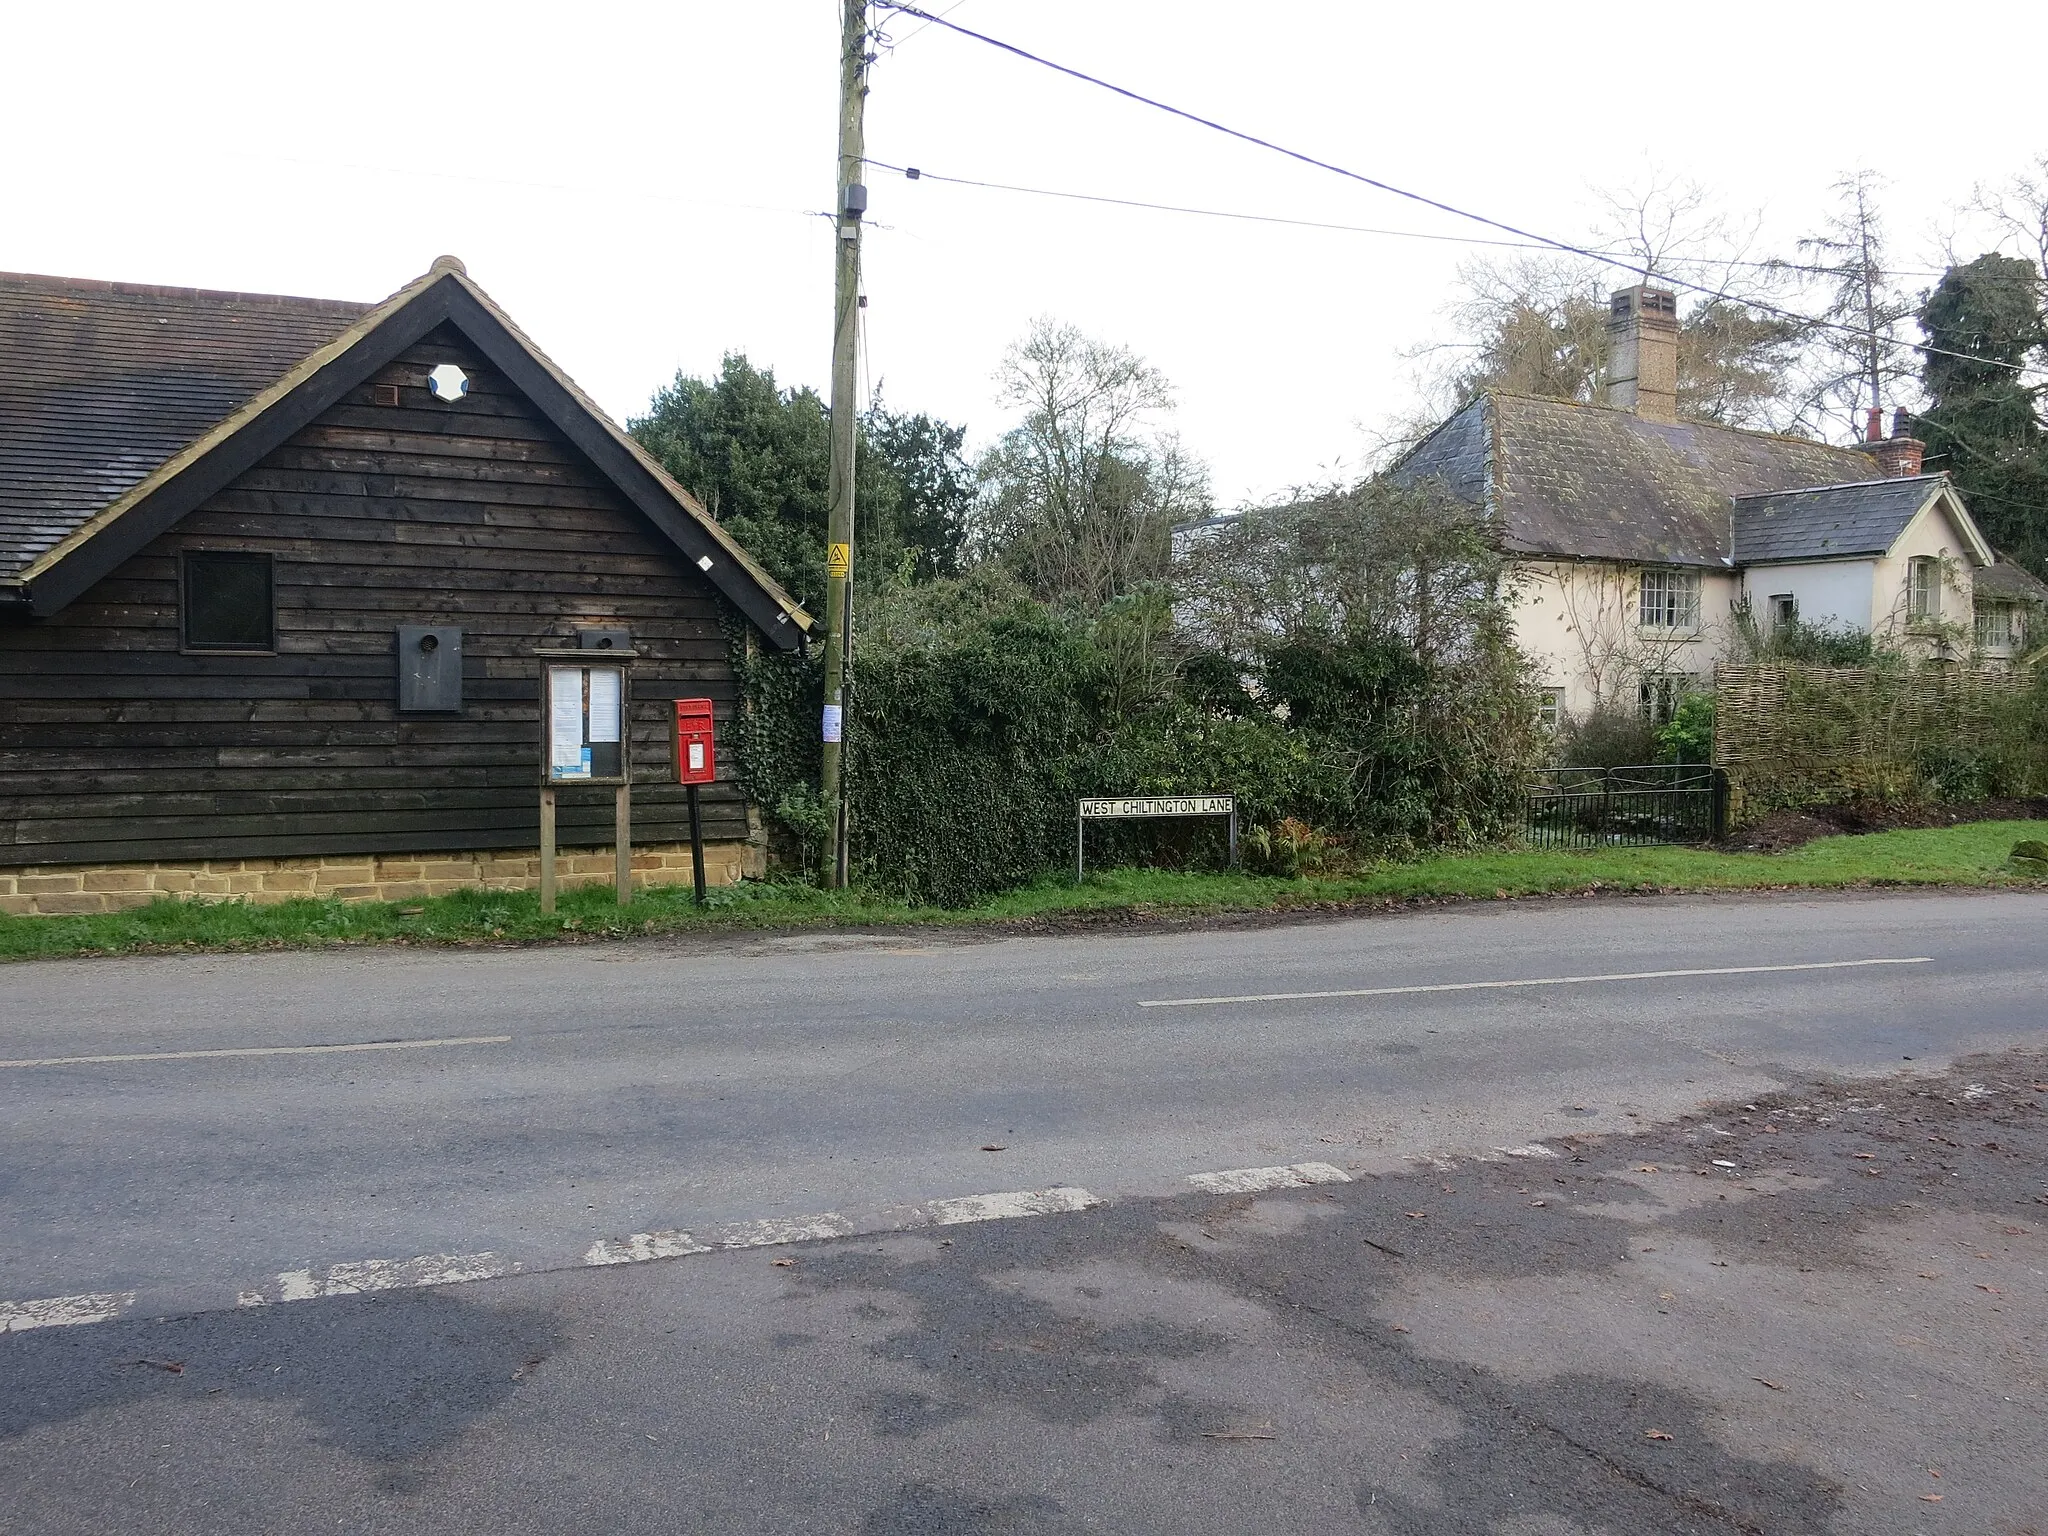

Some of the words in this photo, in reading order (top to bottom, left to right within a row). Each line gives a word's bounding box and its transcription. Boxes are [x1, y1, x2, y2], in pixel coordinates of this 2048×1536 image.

[1082, 801, 1117, 815] WEST
[1122, 800, 1196, 814] CHILTINGTON
[1202, 799, 1231, 812] LANE
